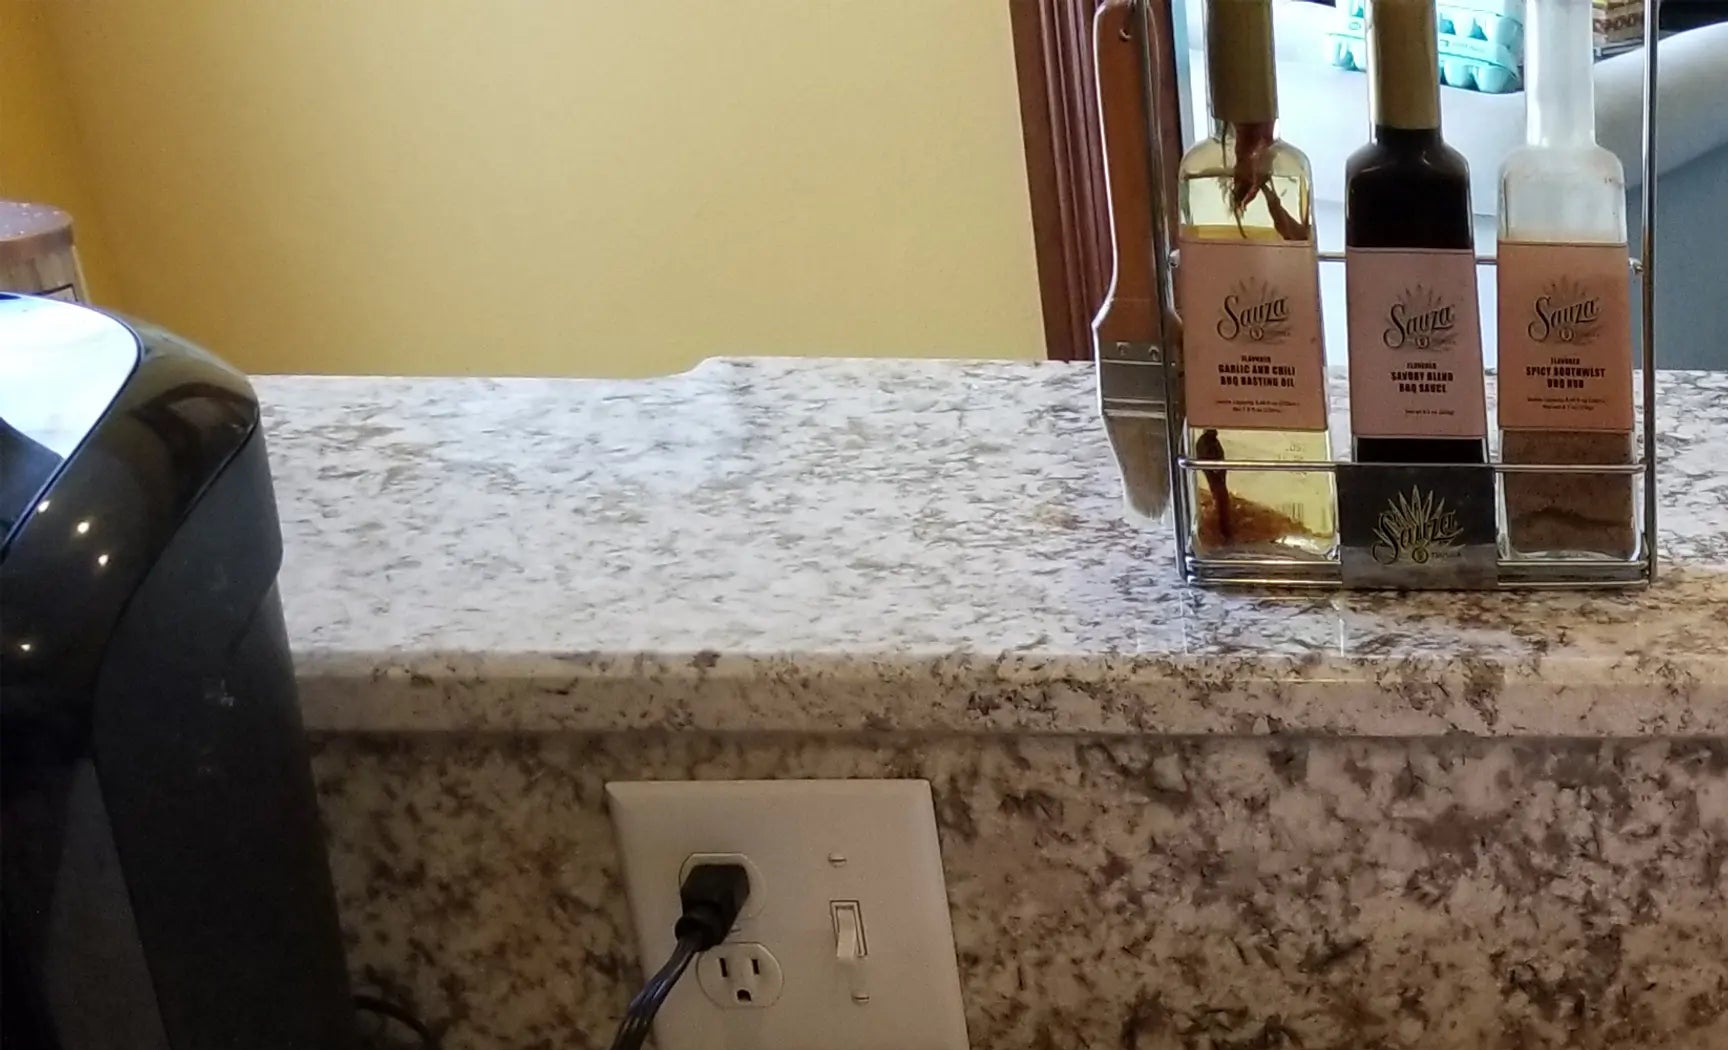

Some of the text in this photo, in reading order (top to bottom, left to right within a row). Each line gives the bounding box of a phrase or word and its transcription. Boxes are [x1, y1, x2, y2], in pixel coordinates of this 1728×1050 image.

[1217, 295, 1289, 341] Sauza
[1528, 296, 1599, 342] Sauza
[1383, 303, 1455, 349] Sauza
[1218, 364, 1295, 376] GARLIC AND CHILI
[1391, 371, 1425, 381] SAVORY
[1526, 366, 1606, 377] SPICY SOUTHWEST
[1220, 376, 1295, 388] BBQ BASTING OIL
[1399, 383, 1447, 393] BBQ SAUCE
[1372, 511, 1463, 565] Sauza
